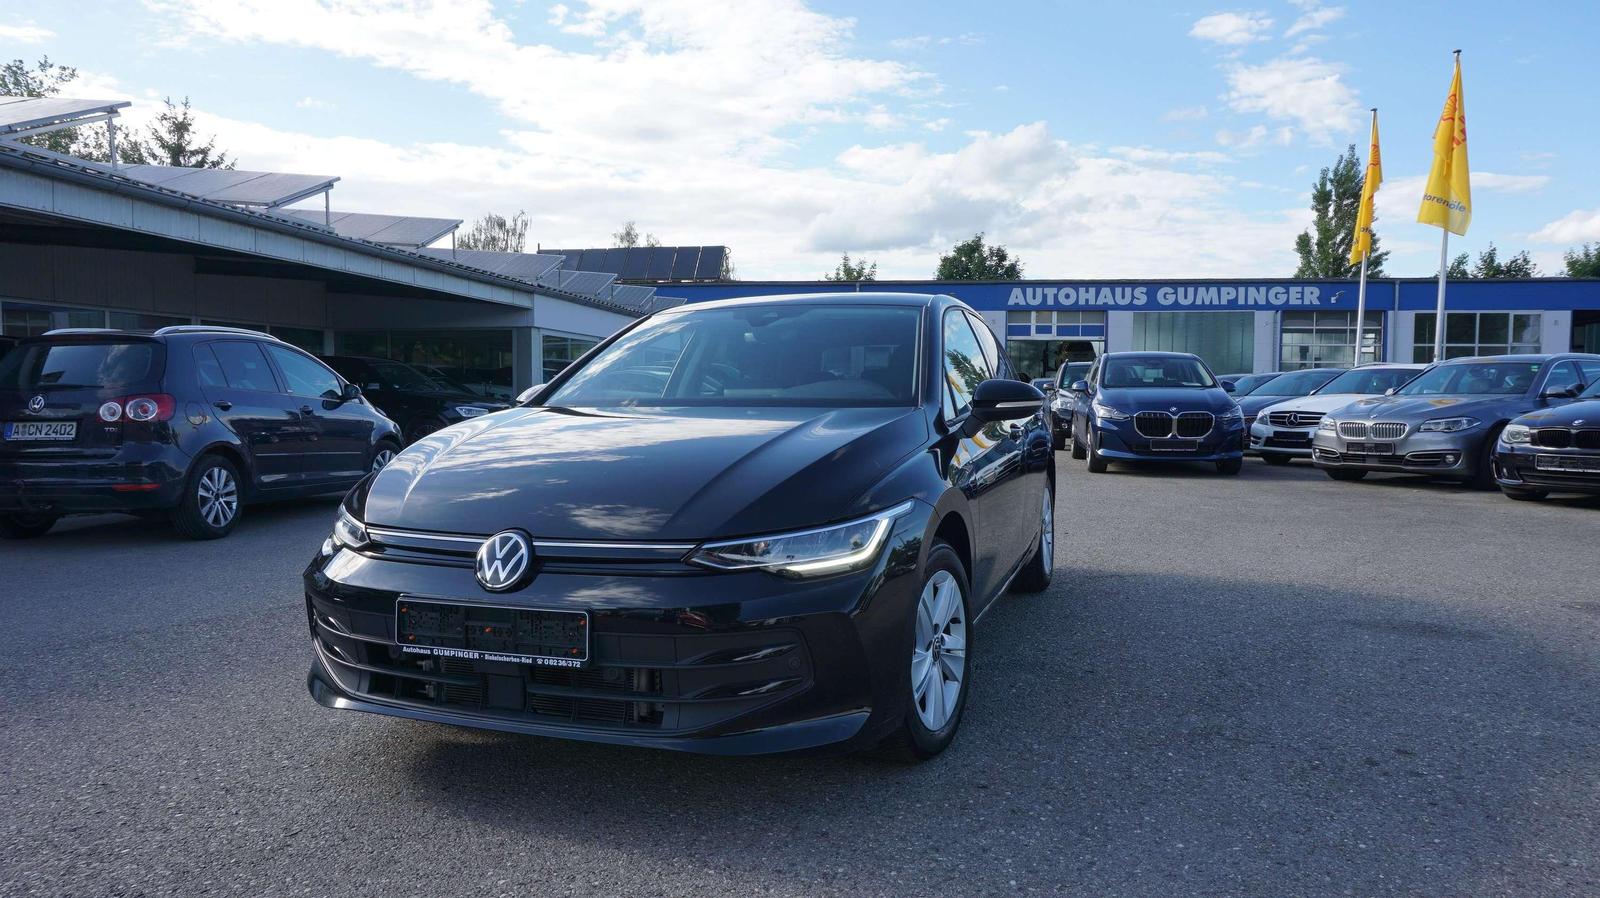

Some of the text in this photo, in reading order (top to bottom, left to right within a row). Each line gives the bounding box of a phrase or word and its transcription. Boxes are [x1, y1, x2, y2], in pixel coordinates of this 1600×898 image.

[1008, 287, 1320, 306] AUTOHAUS GUMPINGER
[12, 423, 75, 436] A CN 2402
[402, 646, 431, 654] Autohaus
[433, 649, 479, 659] GUMPINGER
